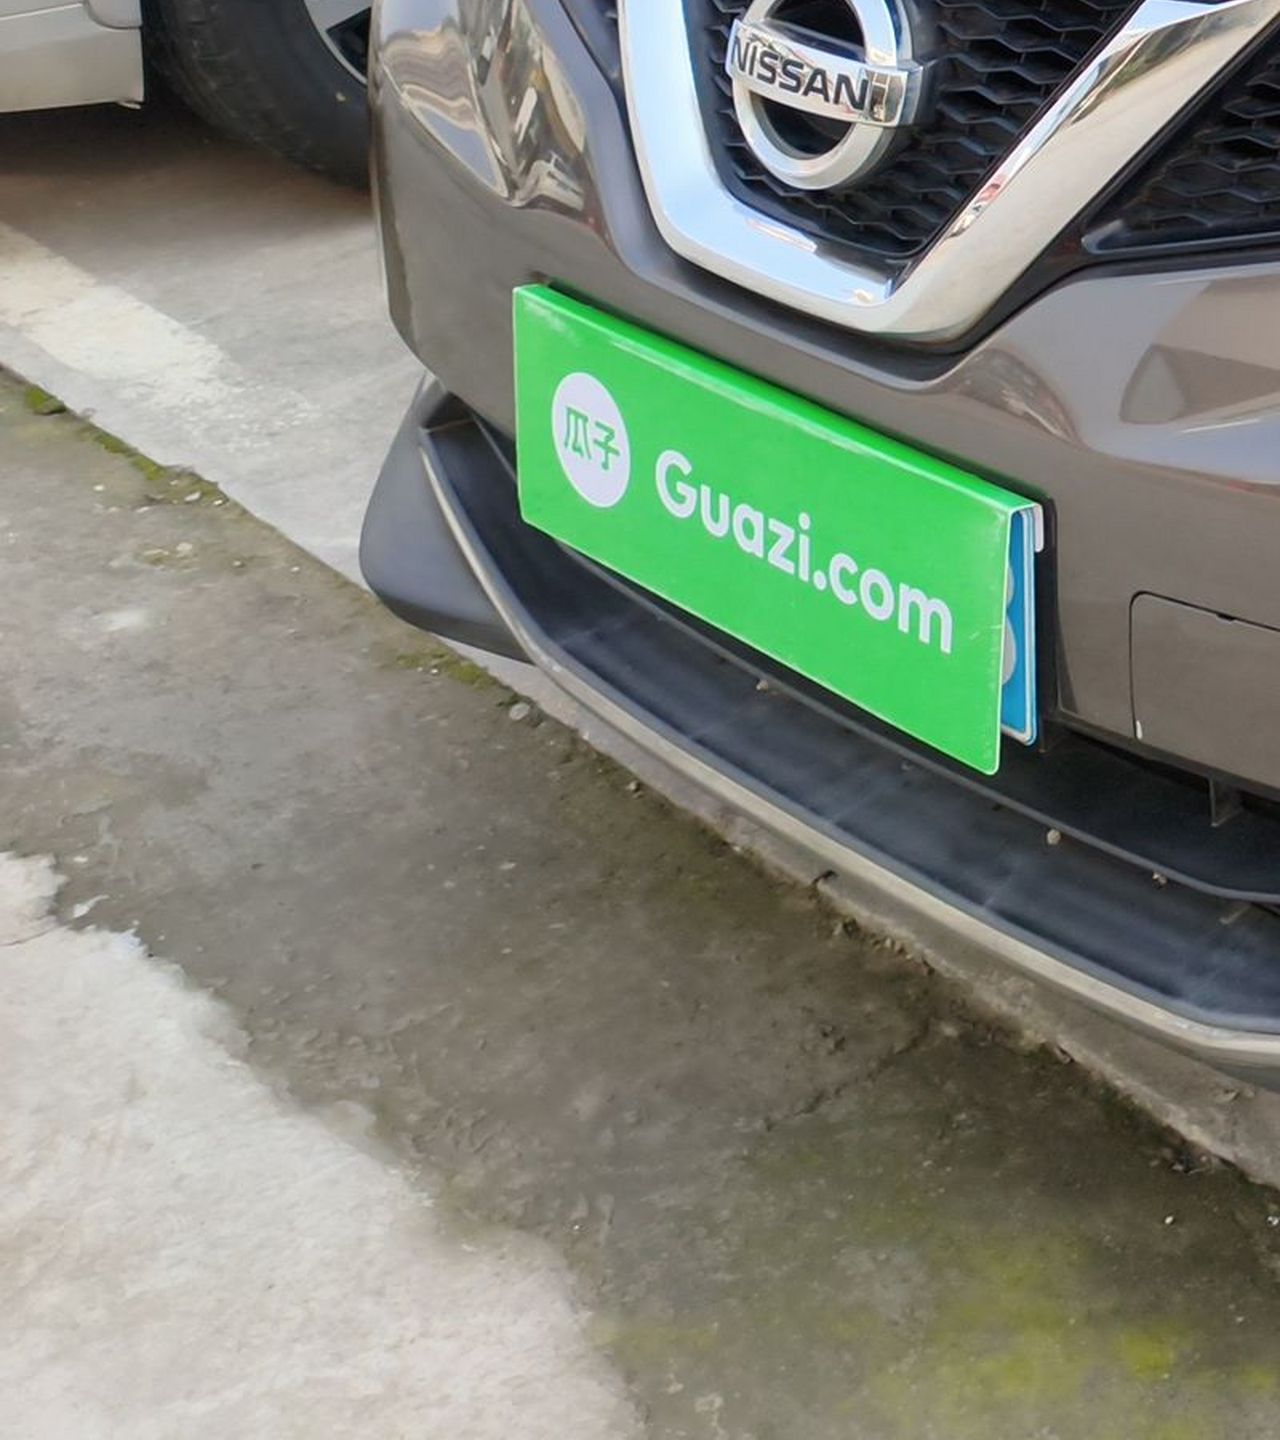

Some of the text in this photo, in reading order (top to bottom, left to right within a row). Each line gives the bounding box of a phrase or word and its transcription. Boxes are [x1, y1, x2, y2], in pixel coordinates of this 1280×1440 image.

[730, 35, 869, 111] NISSAN
[564, 405, 621, 472] 瓜子
[655, 448, 952, 655] Guazi.com
